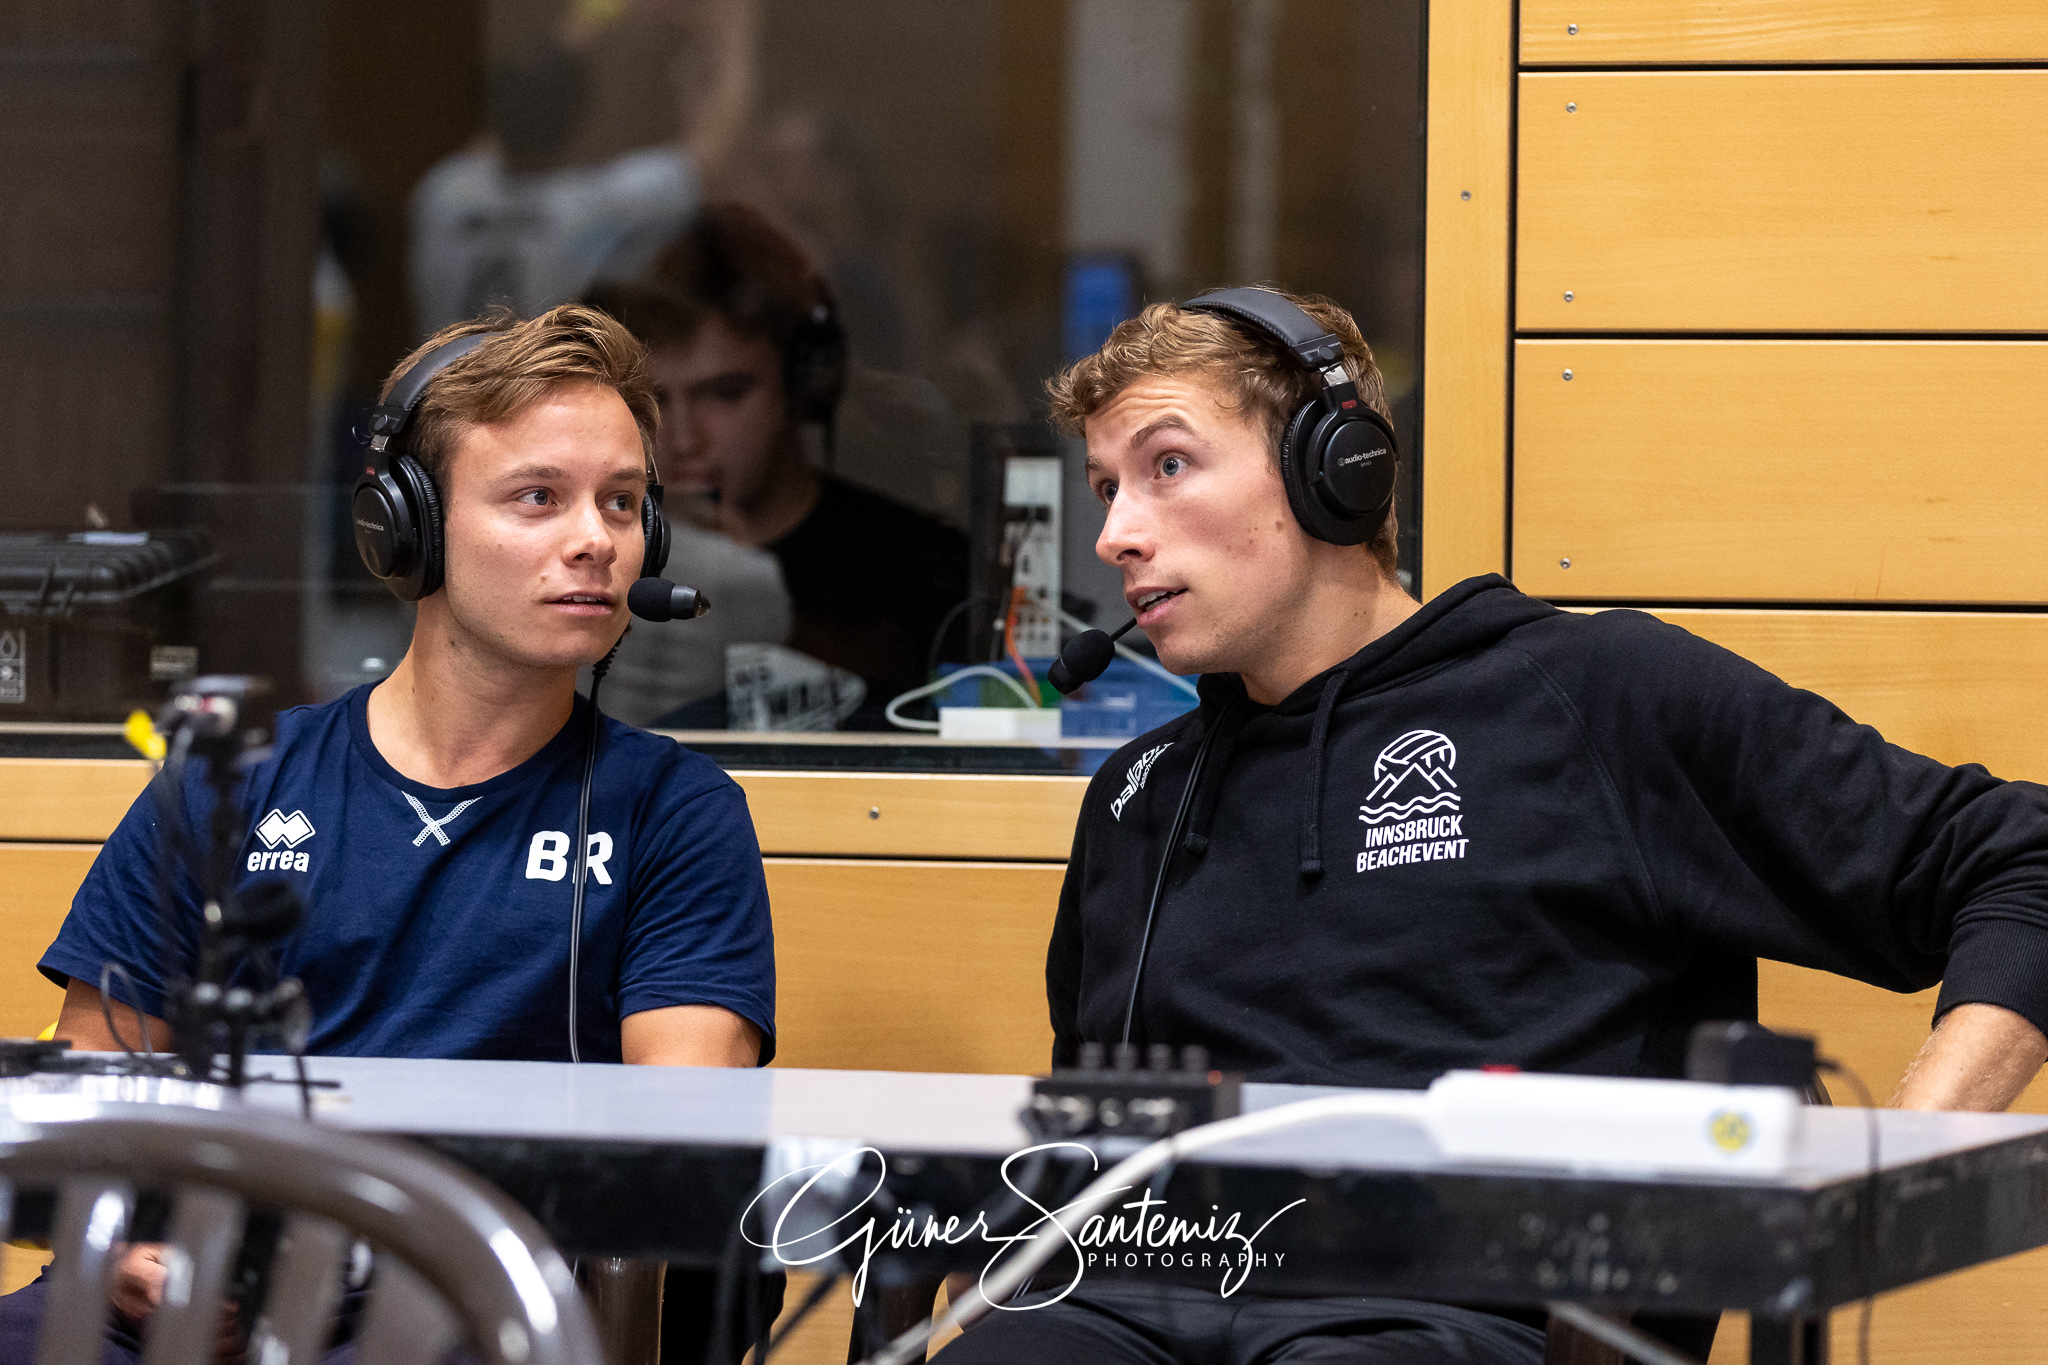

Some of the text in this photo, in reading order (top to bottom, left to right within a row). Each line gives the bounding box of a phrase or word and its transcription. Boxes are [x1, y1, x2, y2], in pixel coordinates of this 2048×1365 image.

[1344, 448, 1387, 464] audio-technica
[355, 518, 384, 532] udio-technica
[1365, 814, 1464, 848] INNSBRUCK
[247, 850, 310, 872] errea
[525, 830, 614, 885] BR
[1356, 838, 1470, 873] BEACHEVENT
